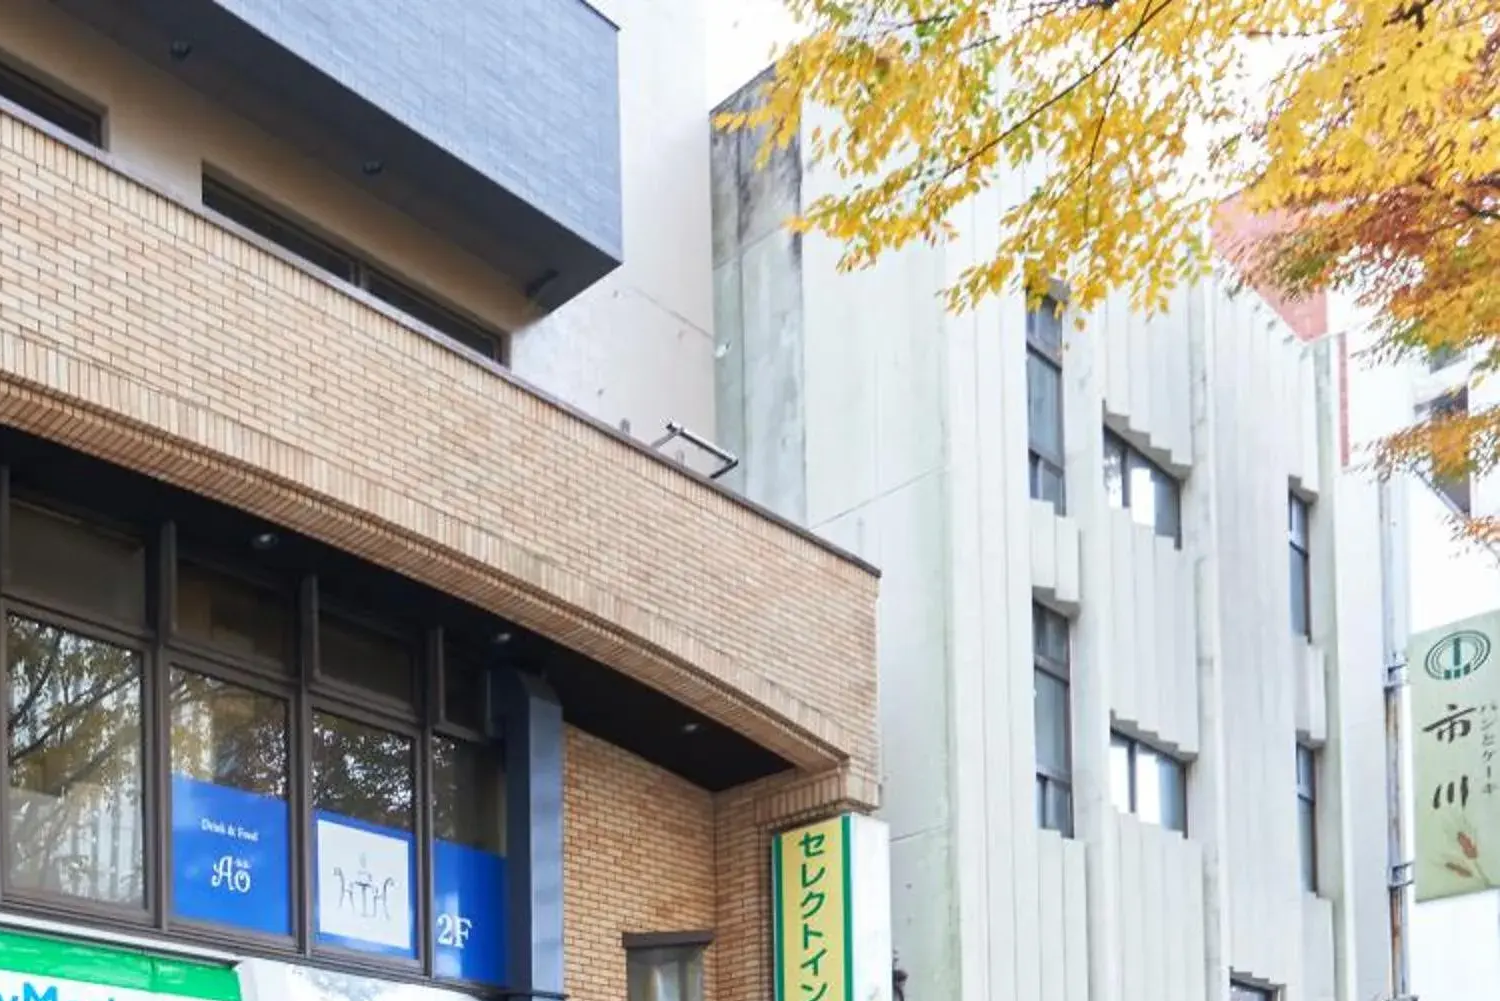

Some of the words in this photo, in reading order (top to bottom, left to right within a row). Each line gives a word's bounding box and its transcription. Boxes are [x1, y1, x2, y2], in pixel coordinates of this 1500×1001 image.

[1423, 703, 1476, 809] 市川
[201, 817, 226, 835] Drink
[237, 827, 259, 842] Food
[438, 914, 472, 948] 2F
